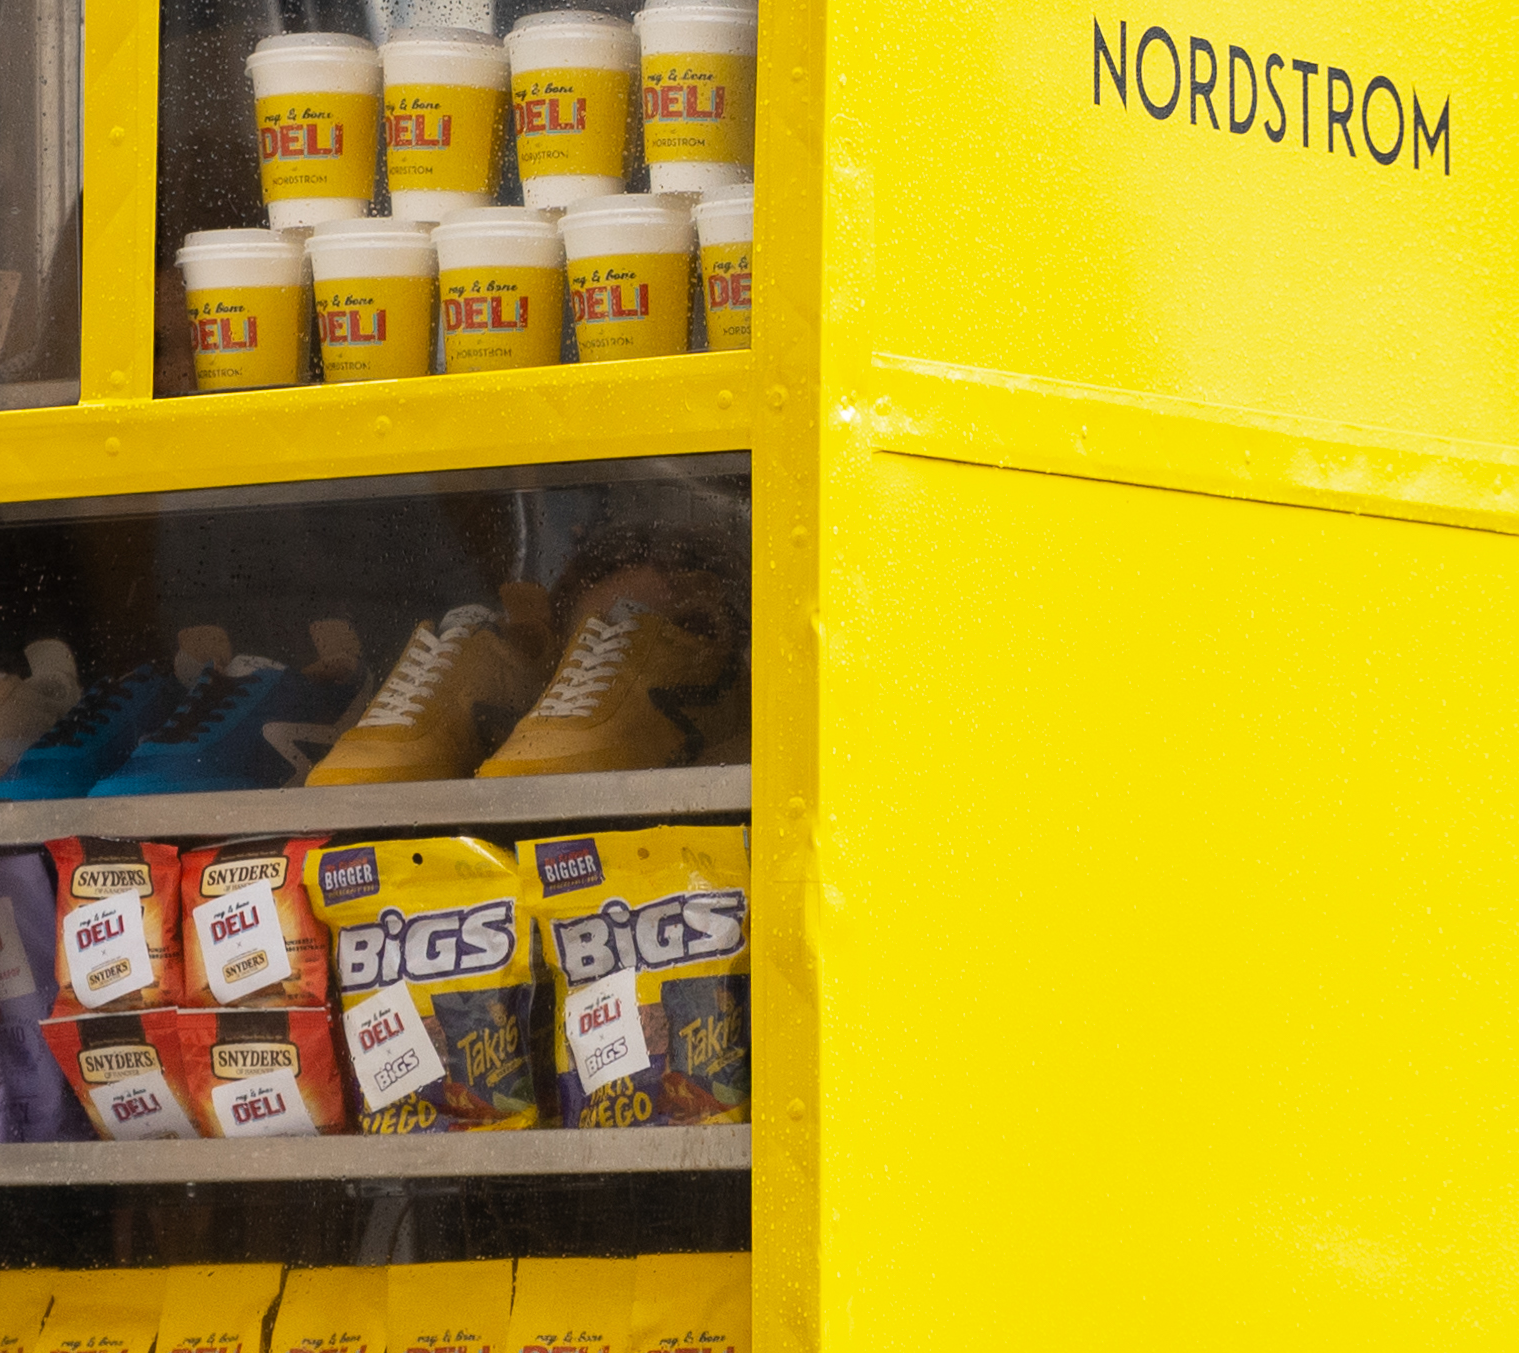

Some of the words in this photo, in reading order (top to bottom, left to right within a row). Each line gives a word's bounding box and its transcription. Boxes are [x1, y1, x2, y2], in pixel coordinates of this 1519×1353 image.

[411, 99, 441, 110] bone
[1092, 16, 1453, 177] NORDSTROM
[261, 123, 344, 164] DELI
[345, 295, 374, 306] bone
[443, 296, 528, 335] DELI
[78, 870, 146, 887] SNYDER'S
[207, 862, 281, 886] SNYDER'S
[325, 863, 373, 891] BIGGER
[545, 855, 597, 883] BIGGER
[76, 915, 125, 953] DELI
[210, 905, 260, 945] DELI
[89, 961, 128, 984] SNYDER'S
[226, 954, 265, 978] SNYDER'S
[579, 999, 621, 1037] DELI
[359, 1012, 405, 1054] DELI
[85, 1051, 154, 1072] SNYDER'S
[218, 1049, 292, 1067] SNYDER'S
[112, 1094, 162, 1124] DELI
[232, 1094, 286, 1125] DELI
